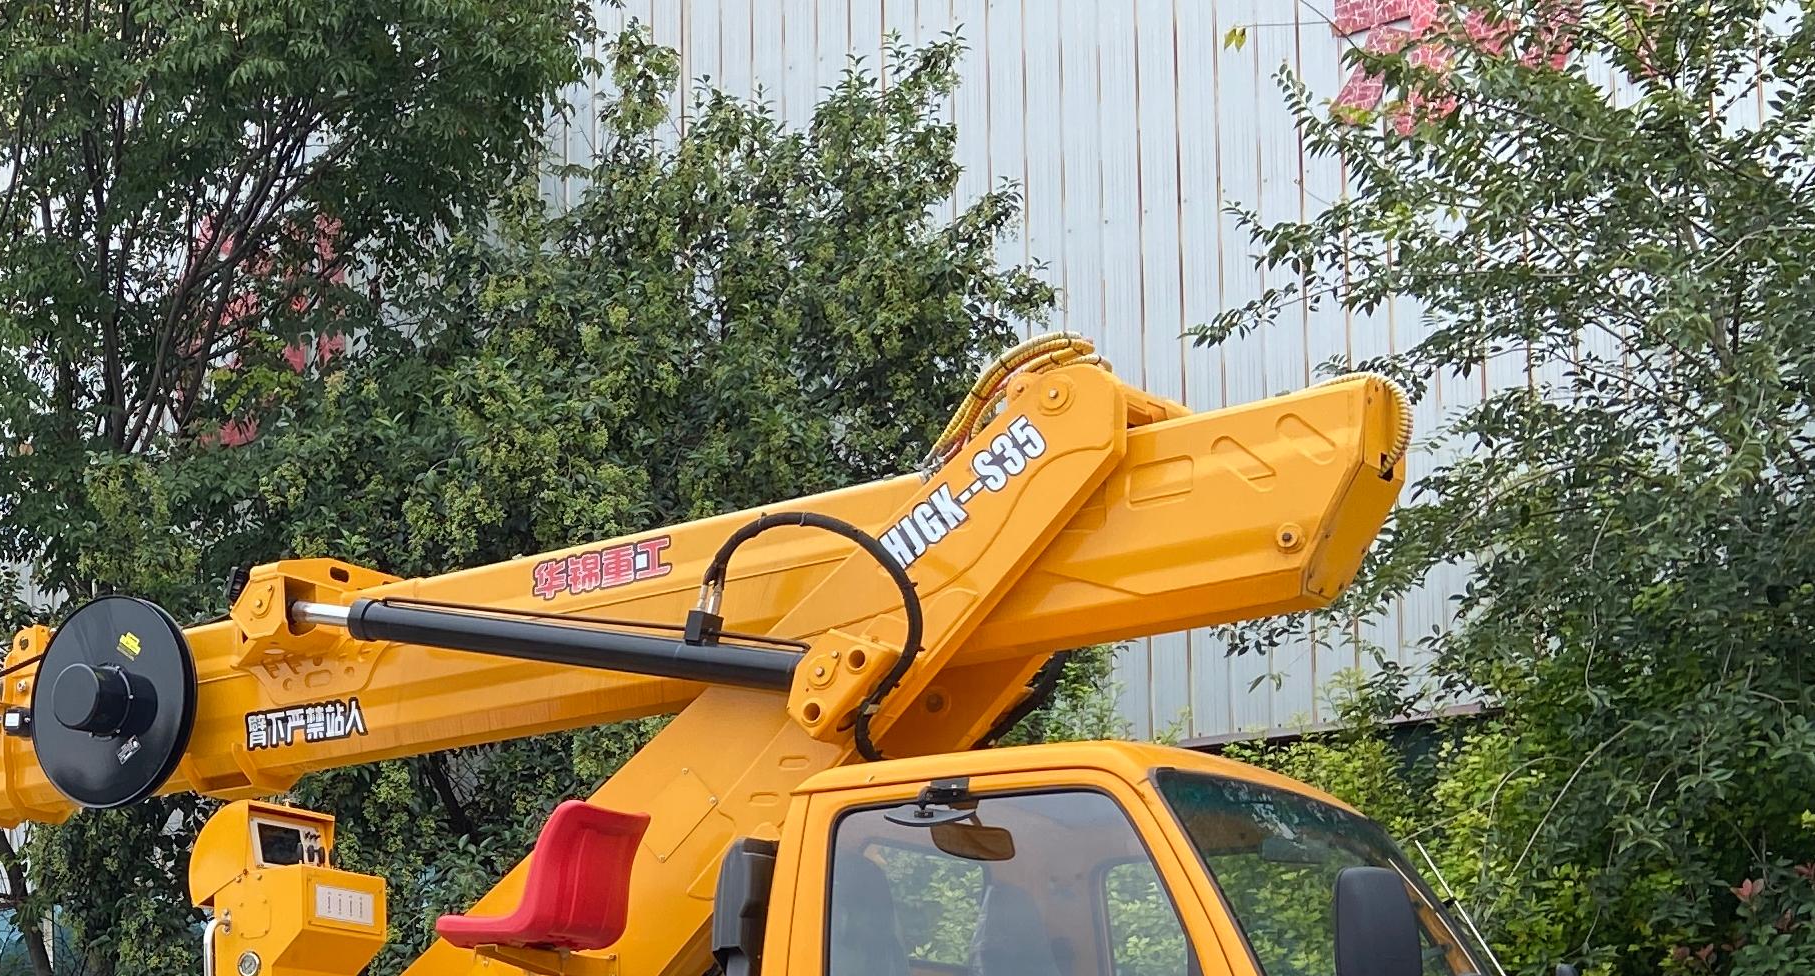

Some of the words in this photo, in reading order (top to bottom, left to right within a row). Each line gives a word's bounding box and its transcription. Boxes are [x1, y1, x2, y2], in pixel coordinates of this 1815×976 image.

[533, 536, 672, 600] 华锦重工
[246, 697, 367, 750] 臂下严禁站人
